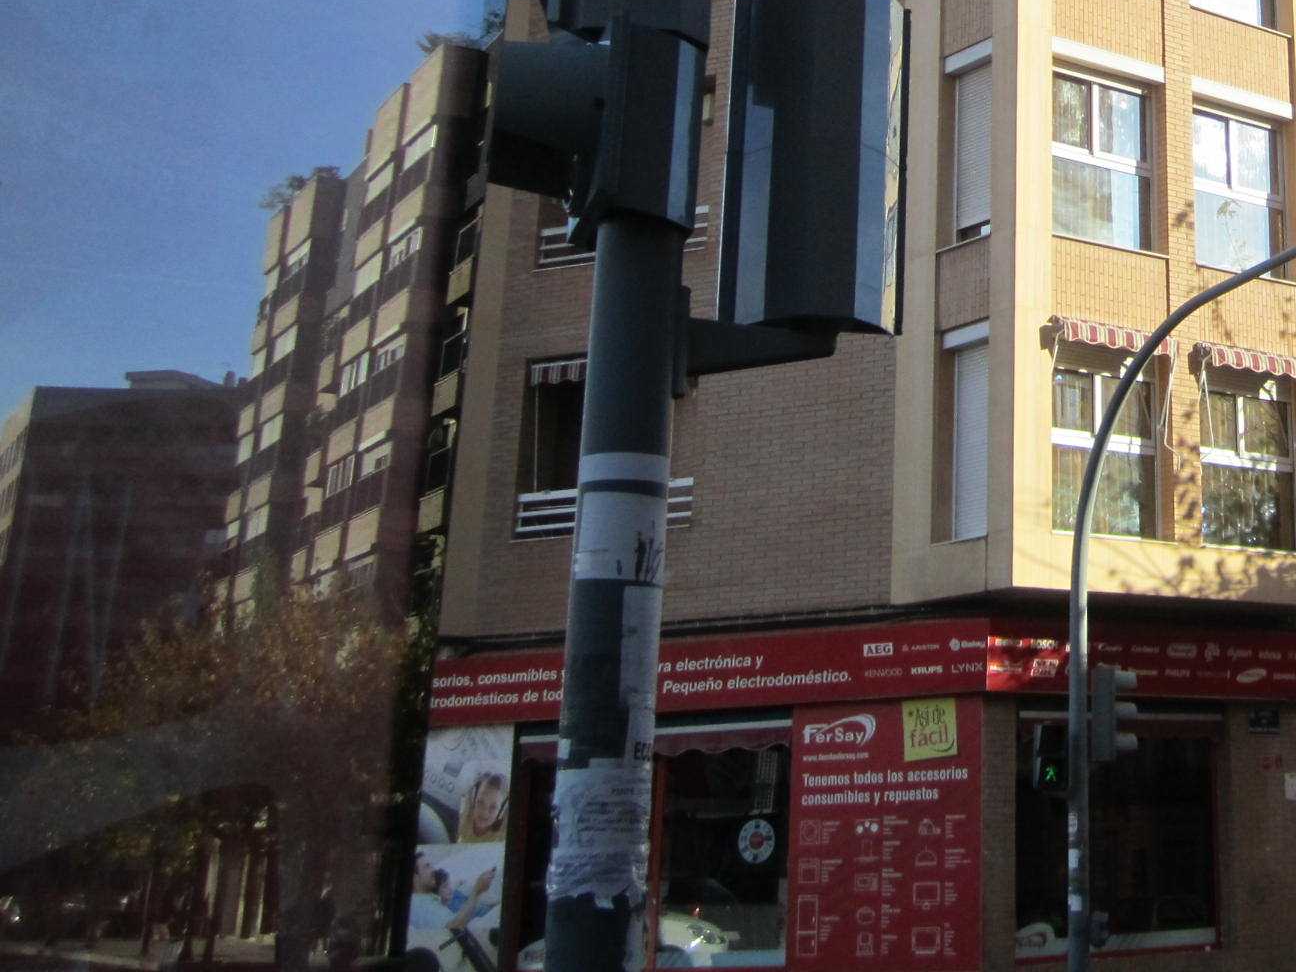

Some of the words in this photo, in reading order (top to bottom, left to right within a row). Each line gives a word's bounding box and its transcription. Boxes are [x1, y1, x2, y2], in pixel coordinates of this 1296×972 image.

[864, 643, 893, 656] AEG
[676, 654, 751, 672] electrónica
[754, 655, 764, 669] y
[911, 665, 943, 675] KRUPS
[951, 662, 984, 674] LYNX
[477, 668, 557, 685] consumibles
[662, 678, 723, 695] Pequeño
[726, 668, 851, 690] electrodoméstico.
[522, 689, 539, 703] de
[803, 724, 866, 746] FerSay
[802, 773, 850, 788] Tenemos
[854, 771, 884, 785] todos
[887, 770, 904, 783] los
[907, 766, 968, 783] accesorios
[802, 790, 871, 806] consumibles
[874, 791, 881, 805] y
[884, 787, 939, 804] repuestos
